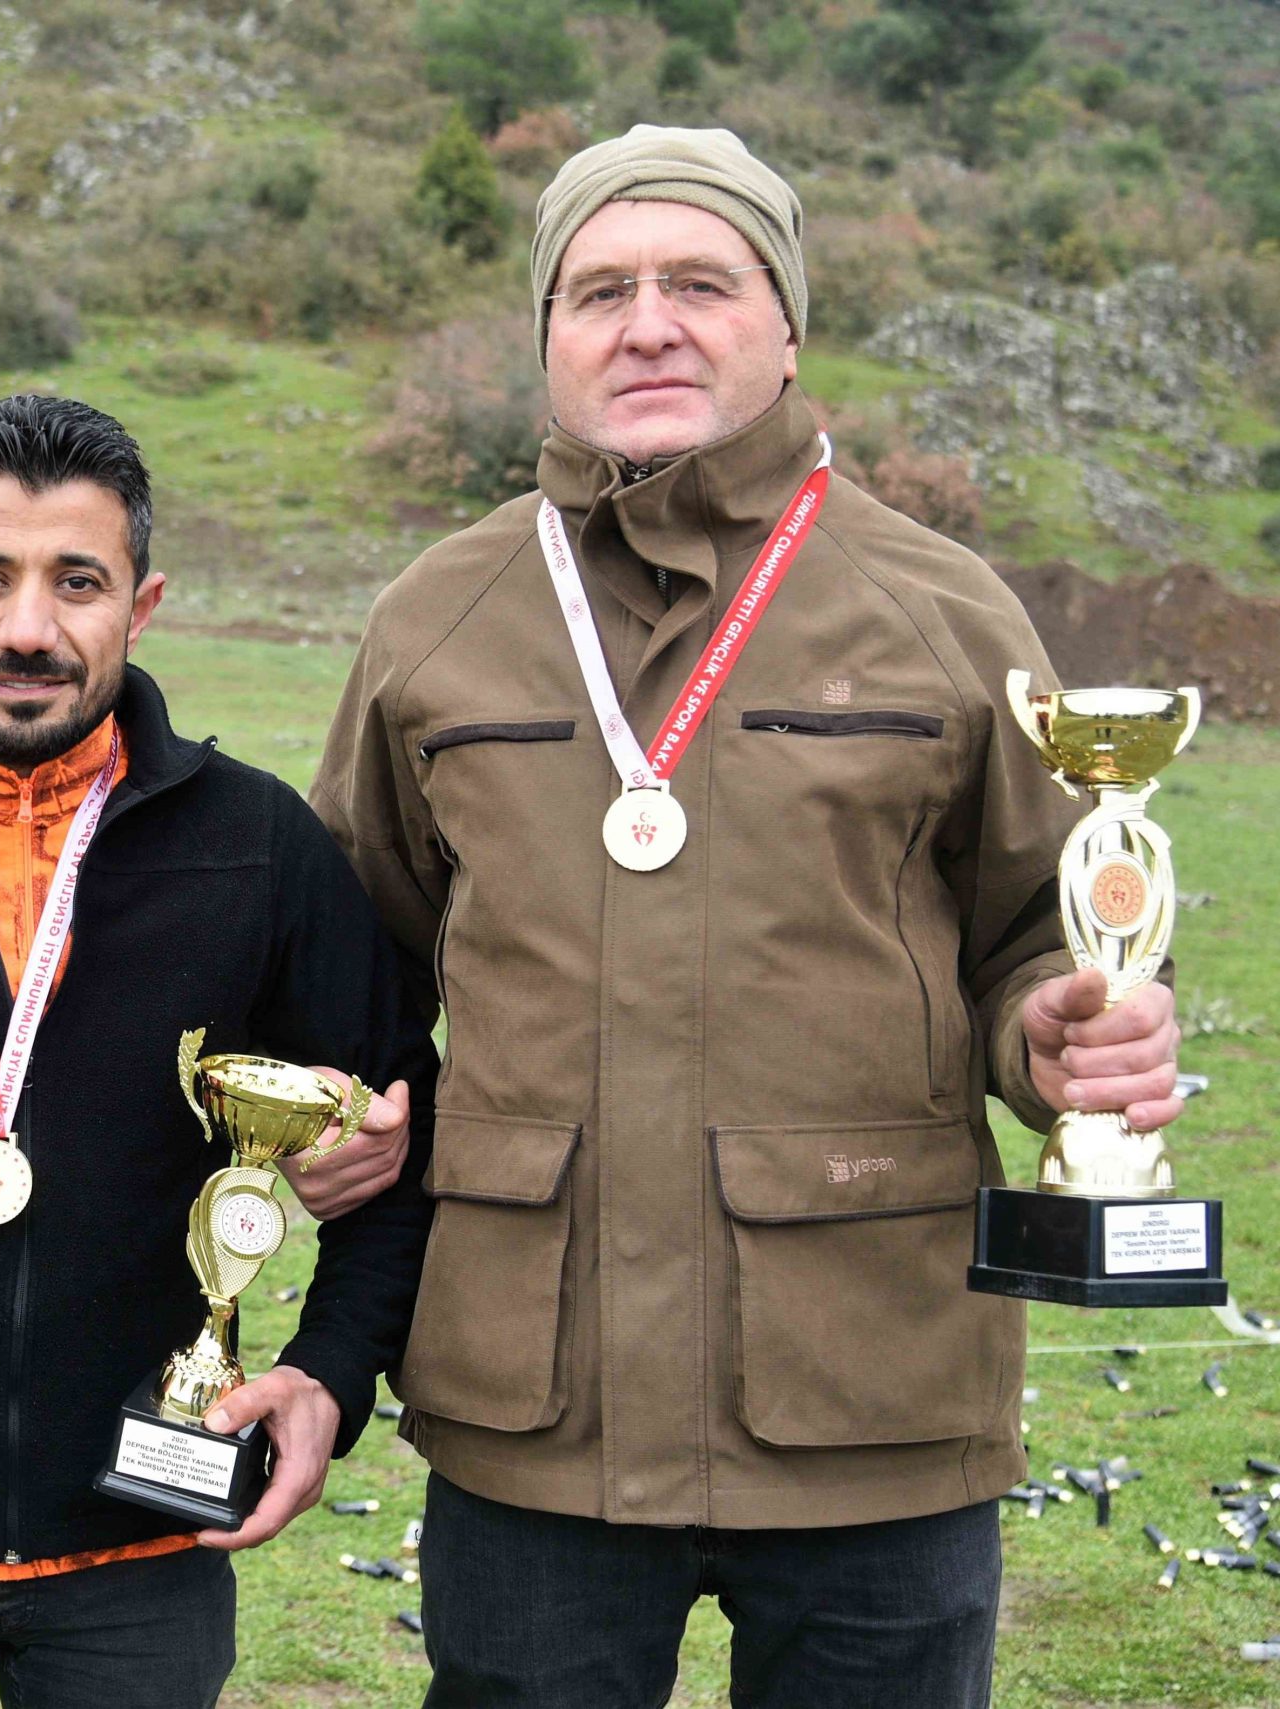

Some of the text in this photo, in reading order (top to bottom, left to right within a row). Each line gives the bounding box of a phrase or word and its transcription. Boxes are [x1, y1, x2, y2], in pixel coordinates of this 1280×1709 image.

[788, 489, 817, 536] TÜRKİYE
[734, 536, 791, 624] CUMHURİYETİ
[704, 622, 743, 679] GENÇLİK
[693, 680, 713, 694] VE
[672, 696, 701, 733] SPOR
[849, 1156, 897, 1178] yaban
[122, 1456, 136, 1465] TEK
[137, 1460, 168, 1473] KURŞUN
[168, 1468, 185, 1479] ATIŞ
[126, 1440, 156, 1453] DEPREM
[191, 1457, 228, 1473] YARARINA
[166, 1459, 188, 1470] Duyan
